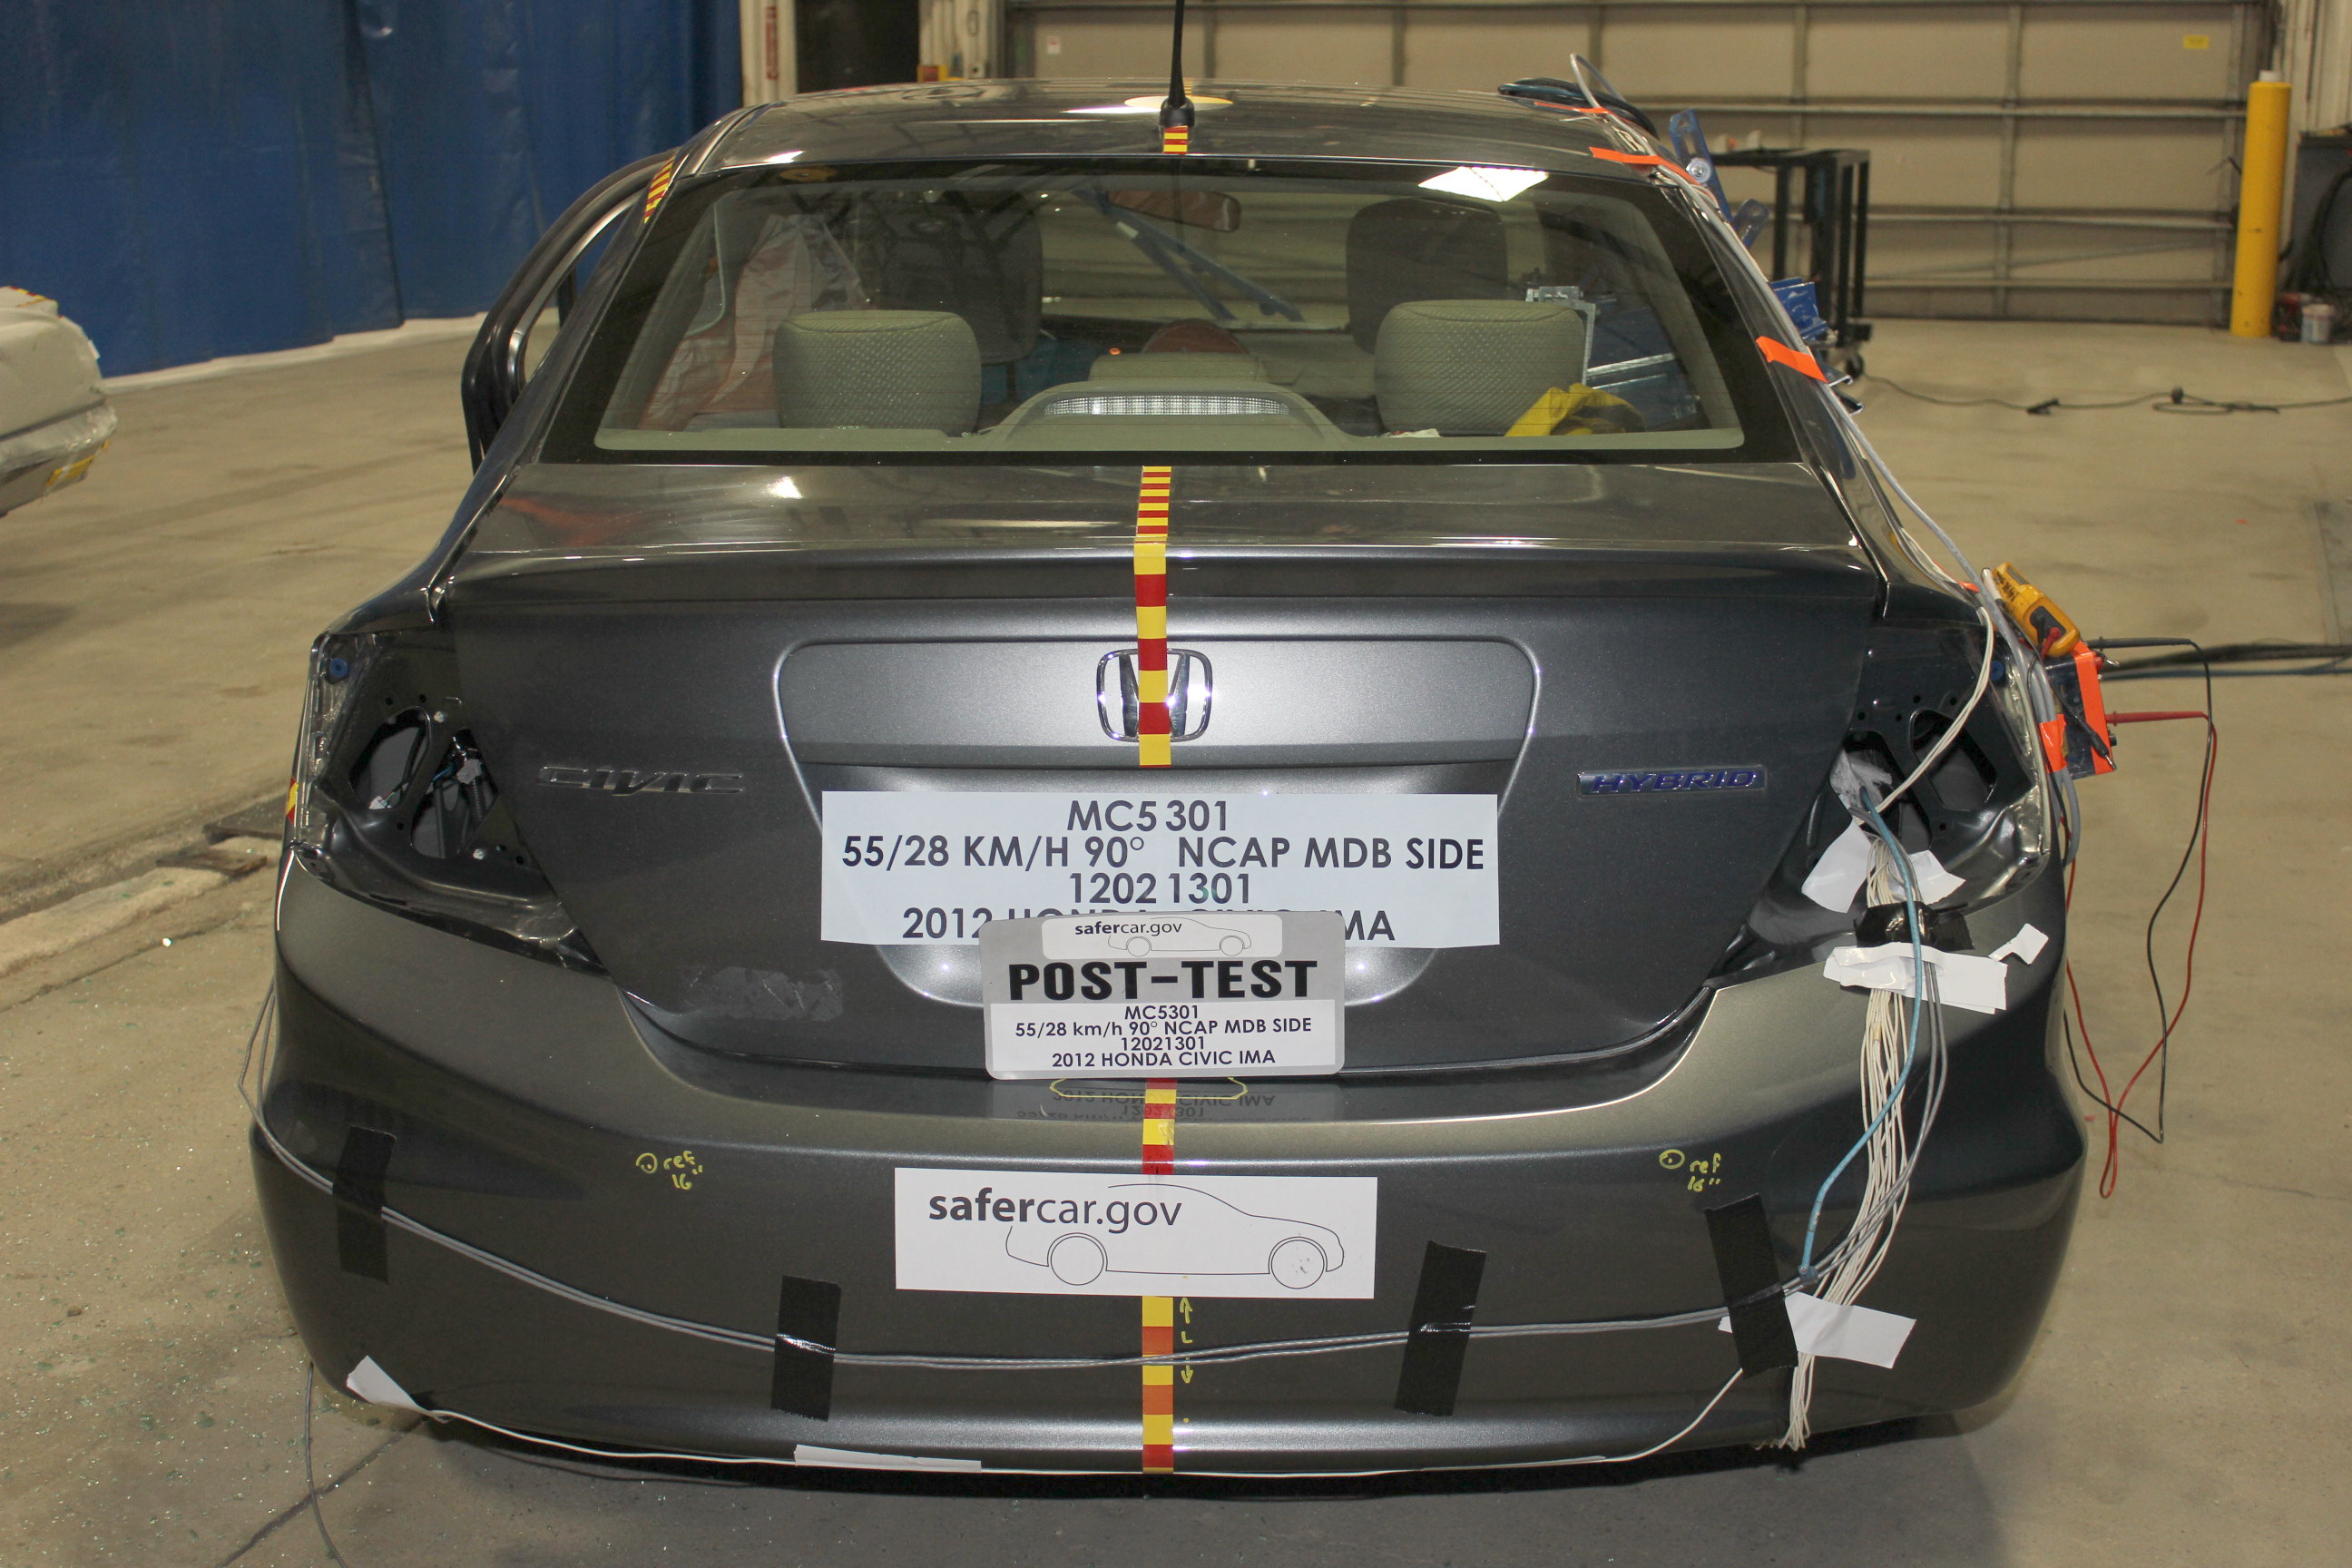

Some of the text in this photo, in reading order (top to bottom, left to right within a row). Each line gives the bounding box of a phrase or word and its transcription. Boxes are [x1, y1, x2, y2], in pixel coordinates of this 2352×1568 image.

[1590, 770, 1757, 793] HYBRID
[842, 834, 1484, 871] 55/28 KM/H 90° NCAP MDB SIDE
[1074, 920, 1182, 936] safercar.gov
[1008, 960, 1318, 1001] POST-TEST
[1124, 1004, 1199, 1020] MC5301
[1014, 1017, 1312, 1039] 55/28 km/h 90° NCAP MDB SIDE
[1121, 1036, 1205, 1051] 12021301
[1052, 1050, 1276, 1067] 2012 HONDA CIVIC IMA
[928, 1187, 1182, 1234] safercar.gov
